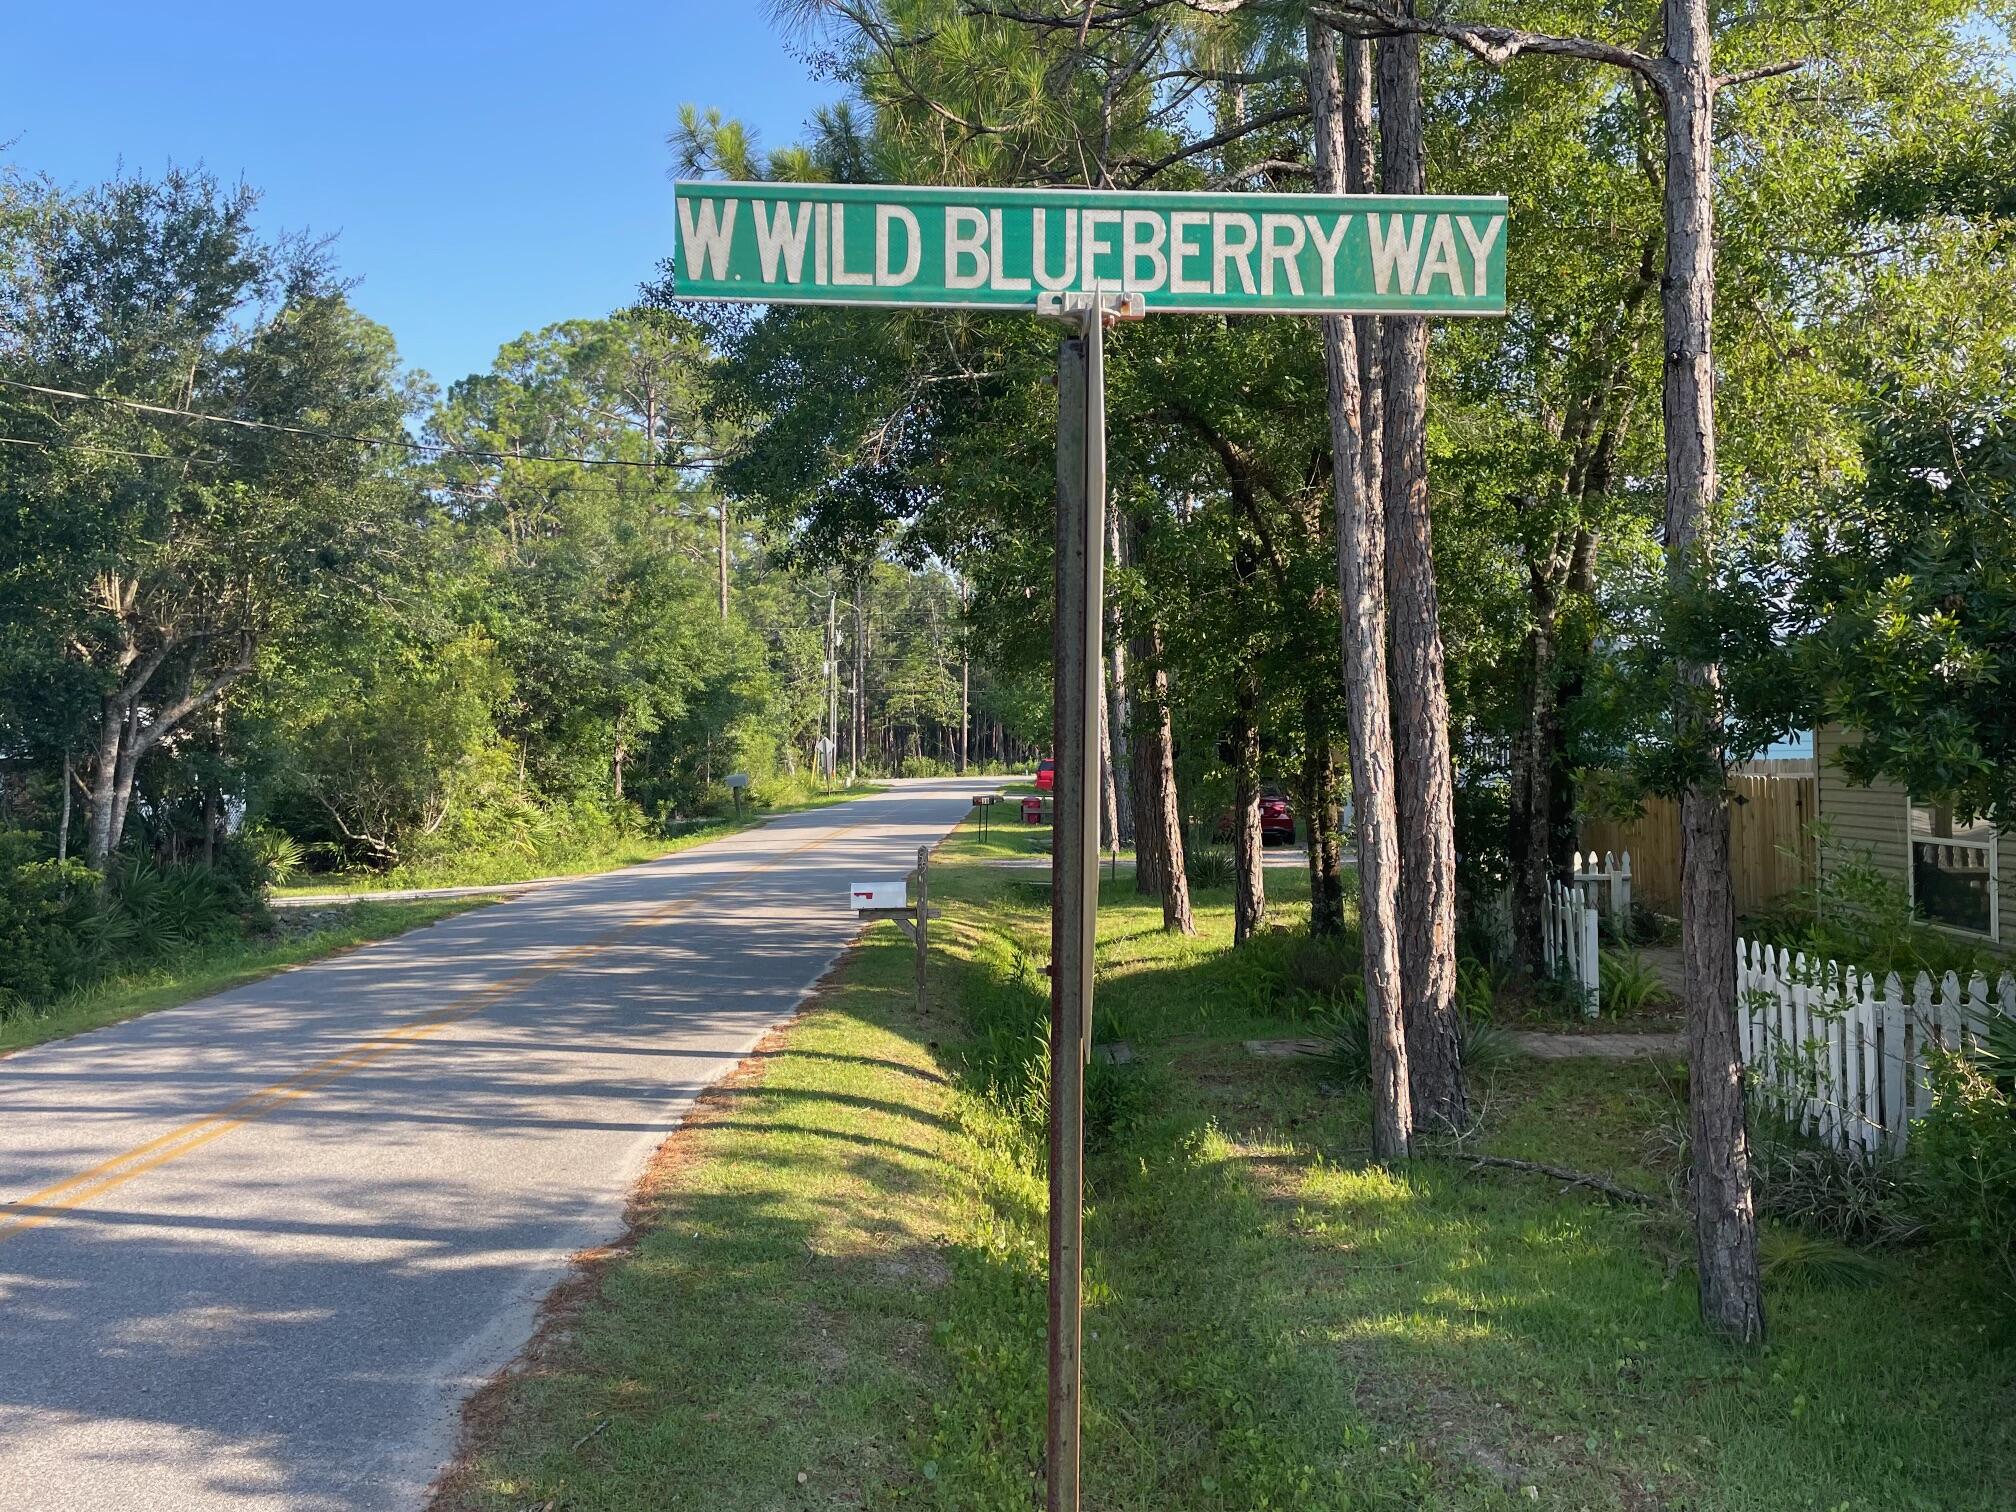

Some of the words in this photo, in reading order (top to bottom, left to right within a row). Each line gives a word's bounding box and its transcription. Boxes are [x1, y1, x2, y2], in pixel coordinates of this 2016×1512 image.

[677, 198, 742, 281] W.
[752, 199, 922, 287] WILD
[945, 206, 1353, 296] BLUEBERRY
[1367, 212, 1504, 297] WAY
